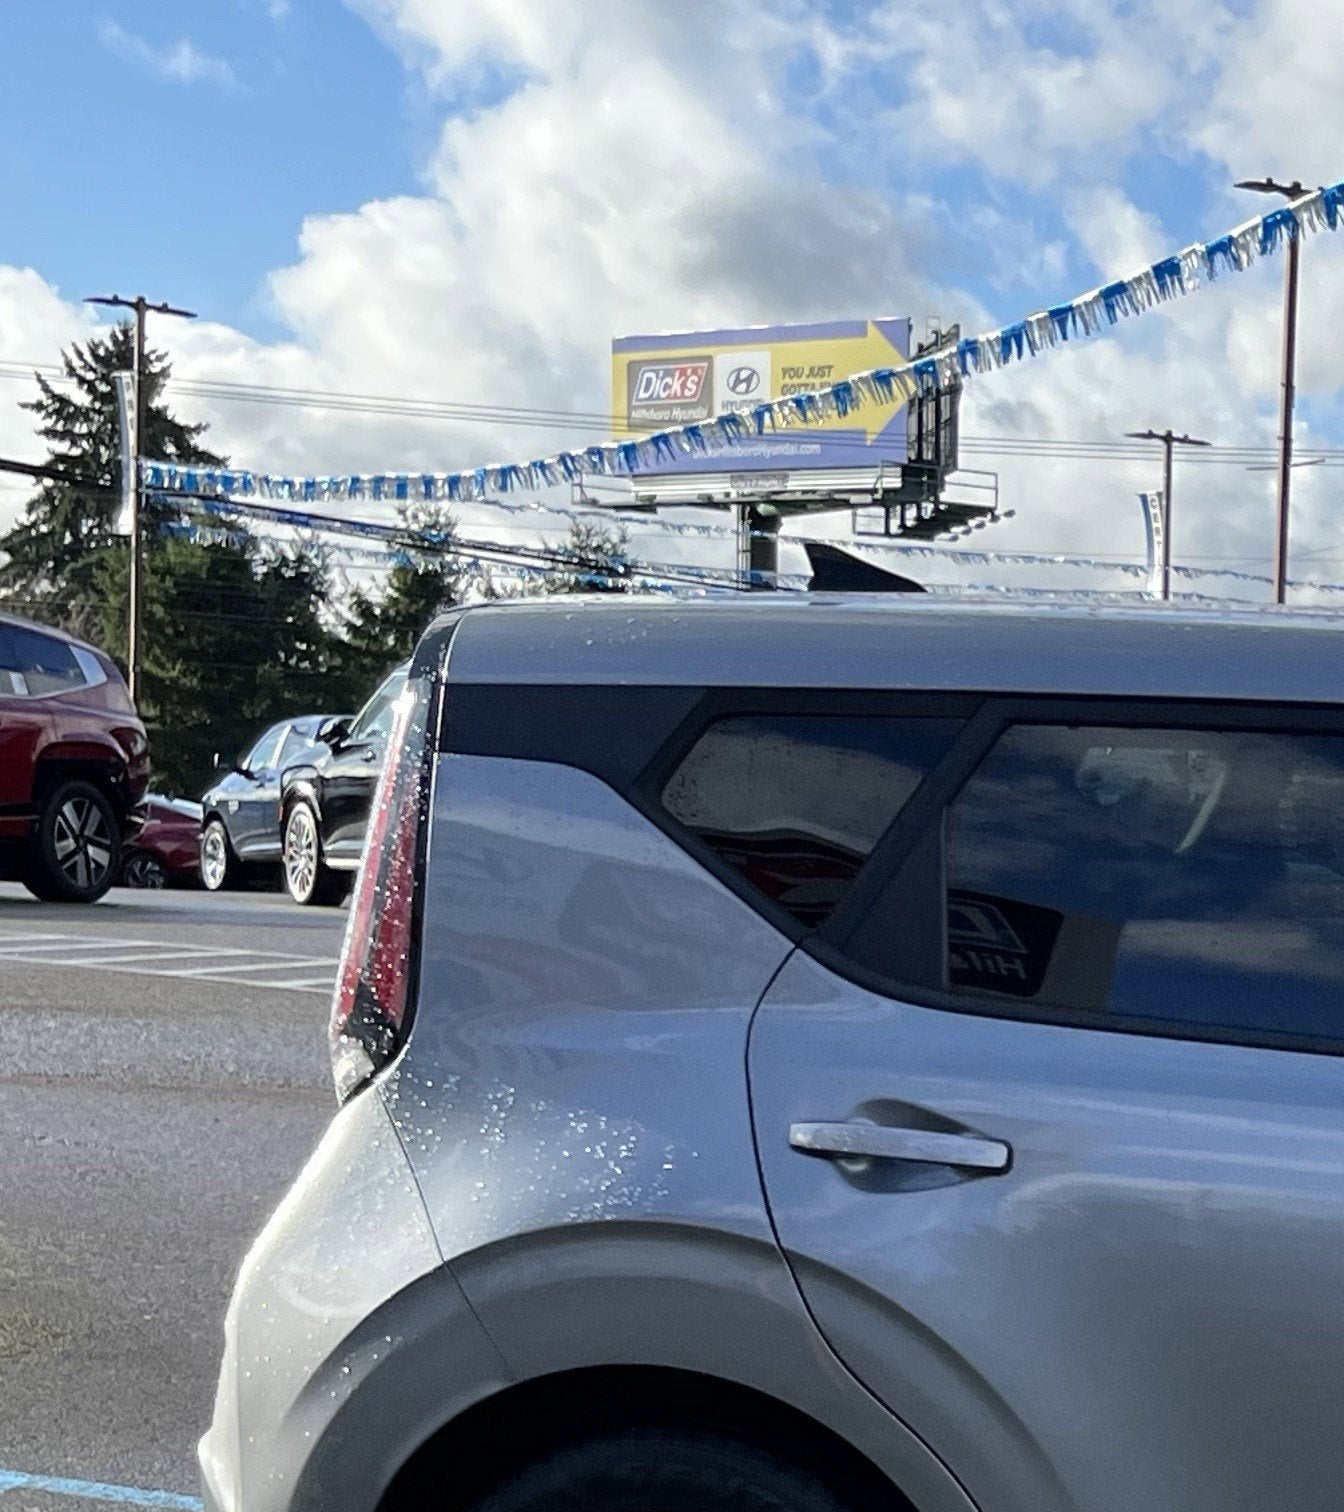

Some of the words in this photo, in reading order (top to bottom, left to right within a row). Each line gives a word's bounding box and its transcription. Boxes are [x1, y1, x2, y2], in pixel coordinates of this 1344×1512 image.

[781, 366, 804, 379] YOU
[806, 365, 834, 378] JUST
[638, 368, 699, 400] Dick's
